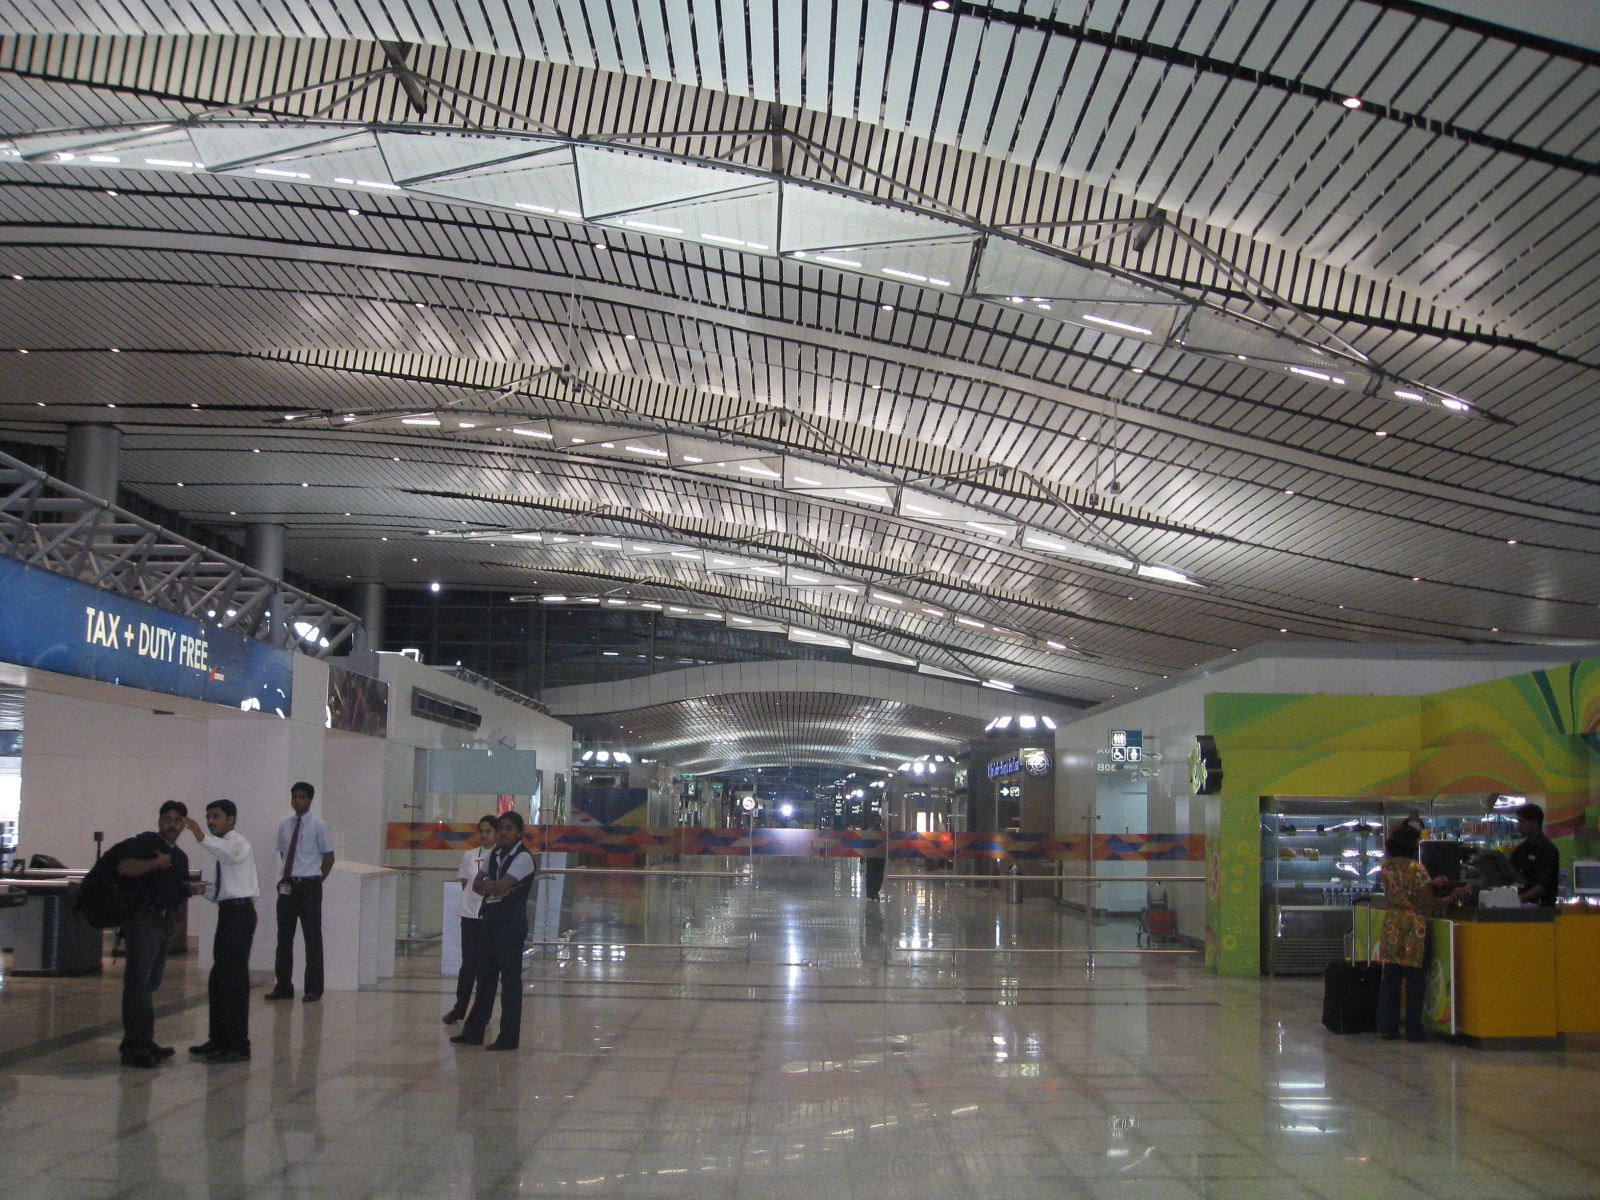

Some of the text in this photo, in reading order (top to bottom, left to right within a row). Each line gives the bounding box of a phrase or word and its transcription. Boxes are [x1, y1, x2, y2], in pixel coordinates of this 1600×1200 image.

[86, 606, 209, 671] TAX + DUTY FREE
